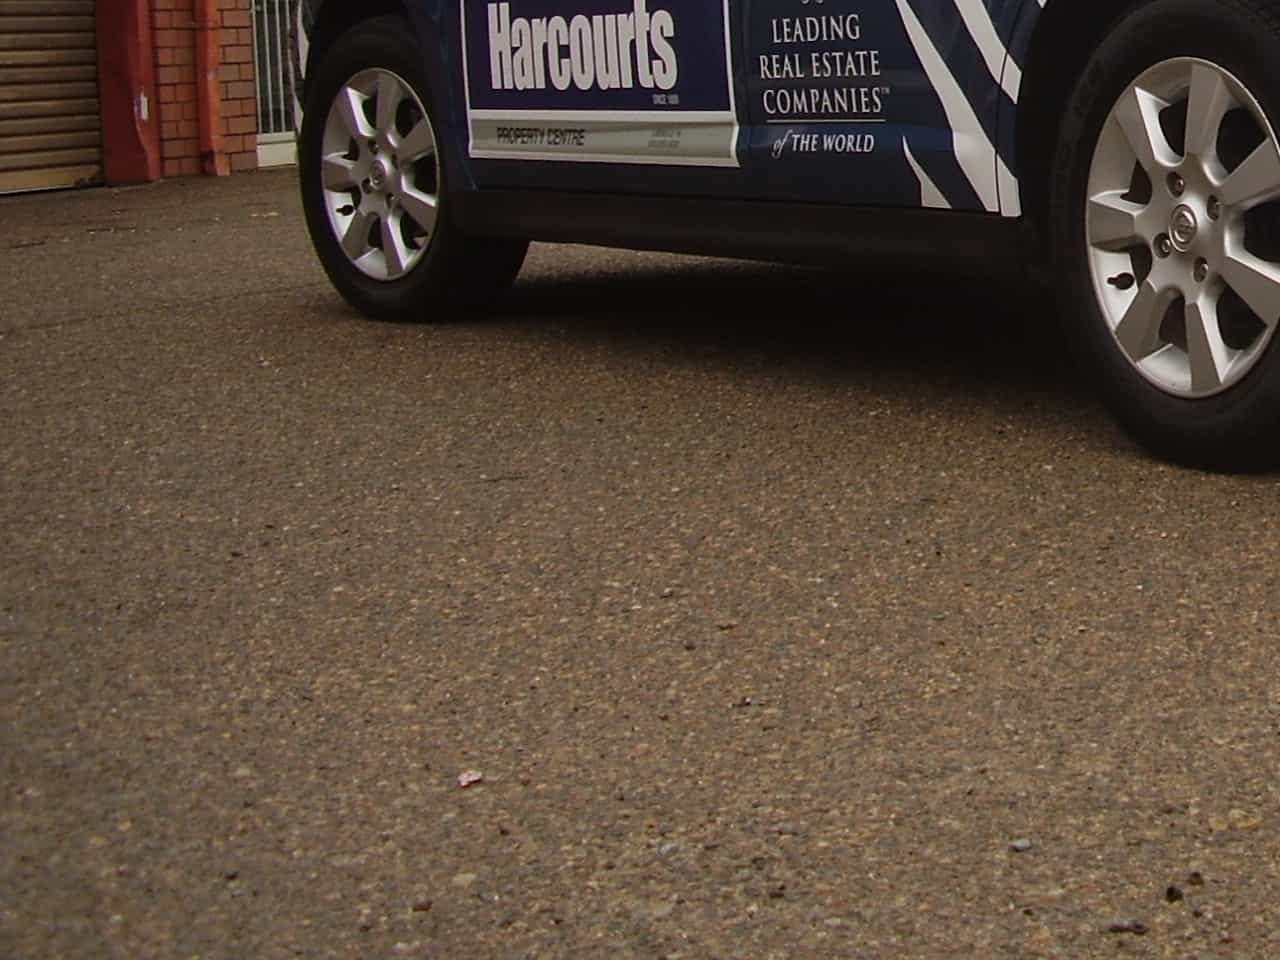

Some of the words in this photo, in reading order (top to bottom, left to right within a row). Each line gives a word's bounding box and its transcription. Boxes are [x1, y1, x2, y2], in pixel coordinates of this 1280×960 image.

[772, 14, 860, 43] LEADING
[759, 53, 805, 79] REAL
[811, 50, 881, 78] ESTATE
[496, 127, 545, 145] PROPERTY
[547, 128, 586, 146] CENTRE
[771, 129, 793, 159] of
[791, 134, 819, 152] THE
[823, 134, 875, 153] WORLD
